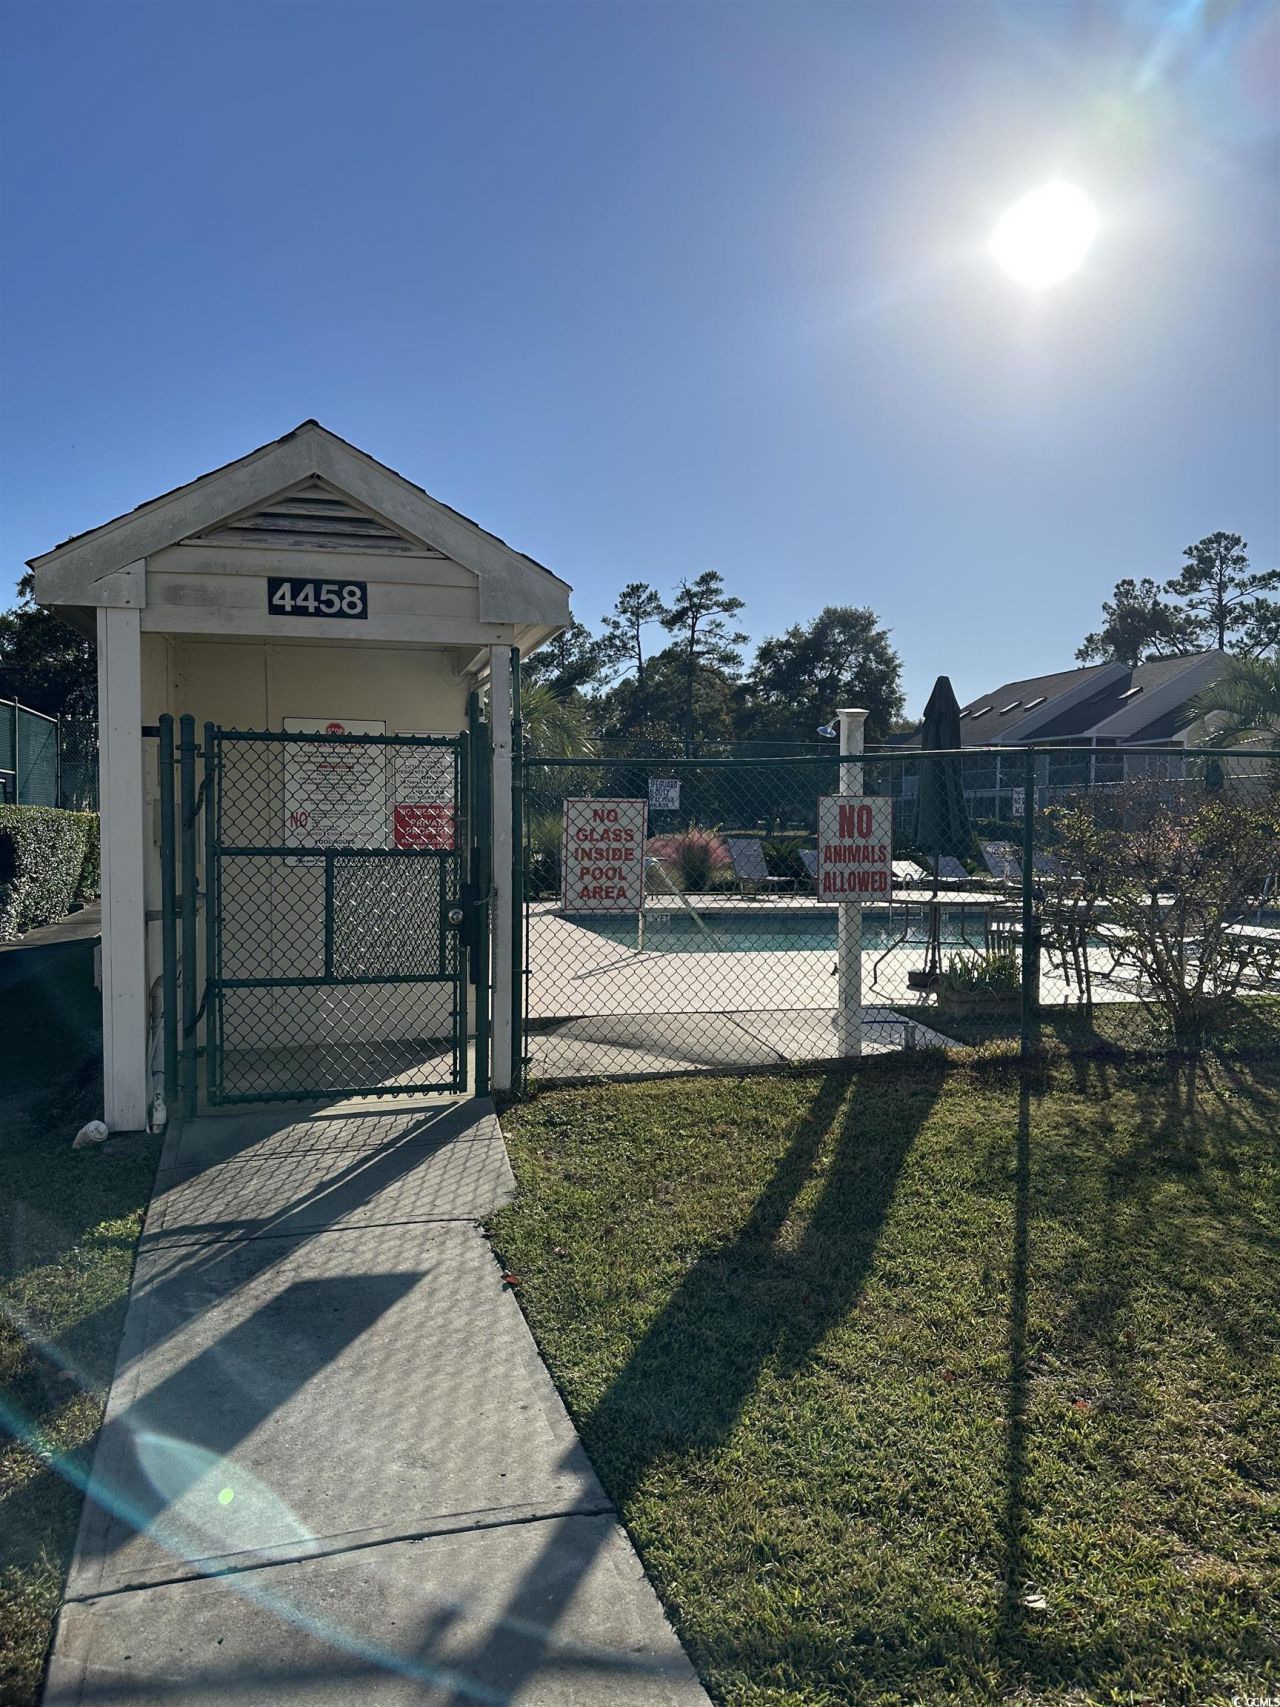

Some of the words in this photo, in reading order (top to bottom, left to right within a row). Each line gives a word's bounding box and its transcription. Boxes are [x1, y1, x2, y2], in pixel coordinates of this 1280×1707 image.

[272, 582, 363, 615] 4458
[290, 811, 308, 828] NO
[593, 809, 618, 822] NO
[839, 804, 872, 839] NO
[411, 819, 448, 827] PRIVATE
[575, 828, 634, 842] GLASS
[574, 848, 634, 861] INSIDE
[823, 845, 887, 863] ANIMALS
[580, 867, 627, 880] POOL
[823, 871, 887, 893] ALLOWED
[579, 885, 626, 899] AREA
